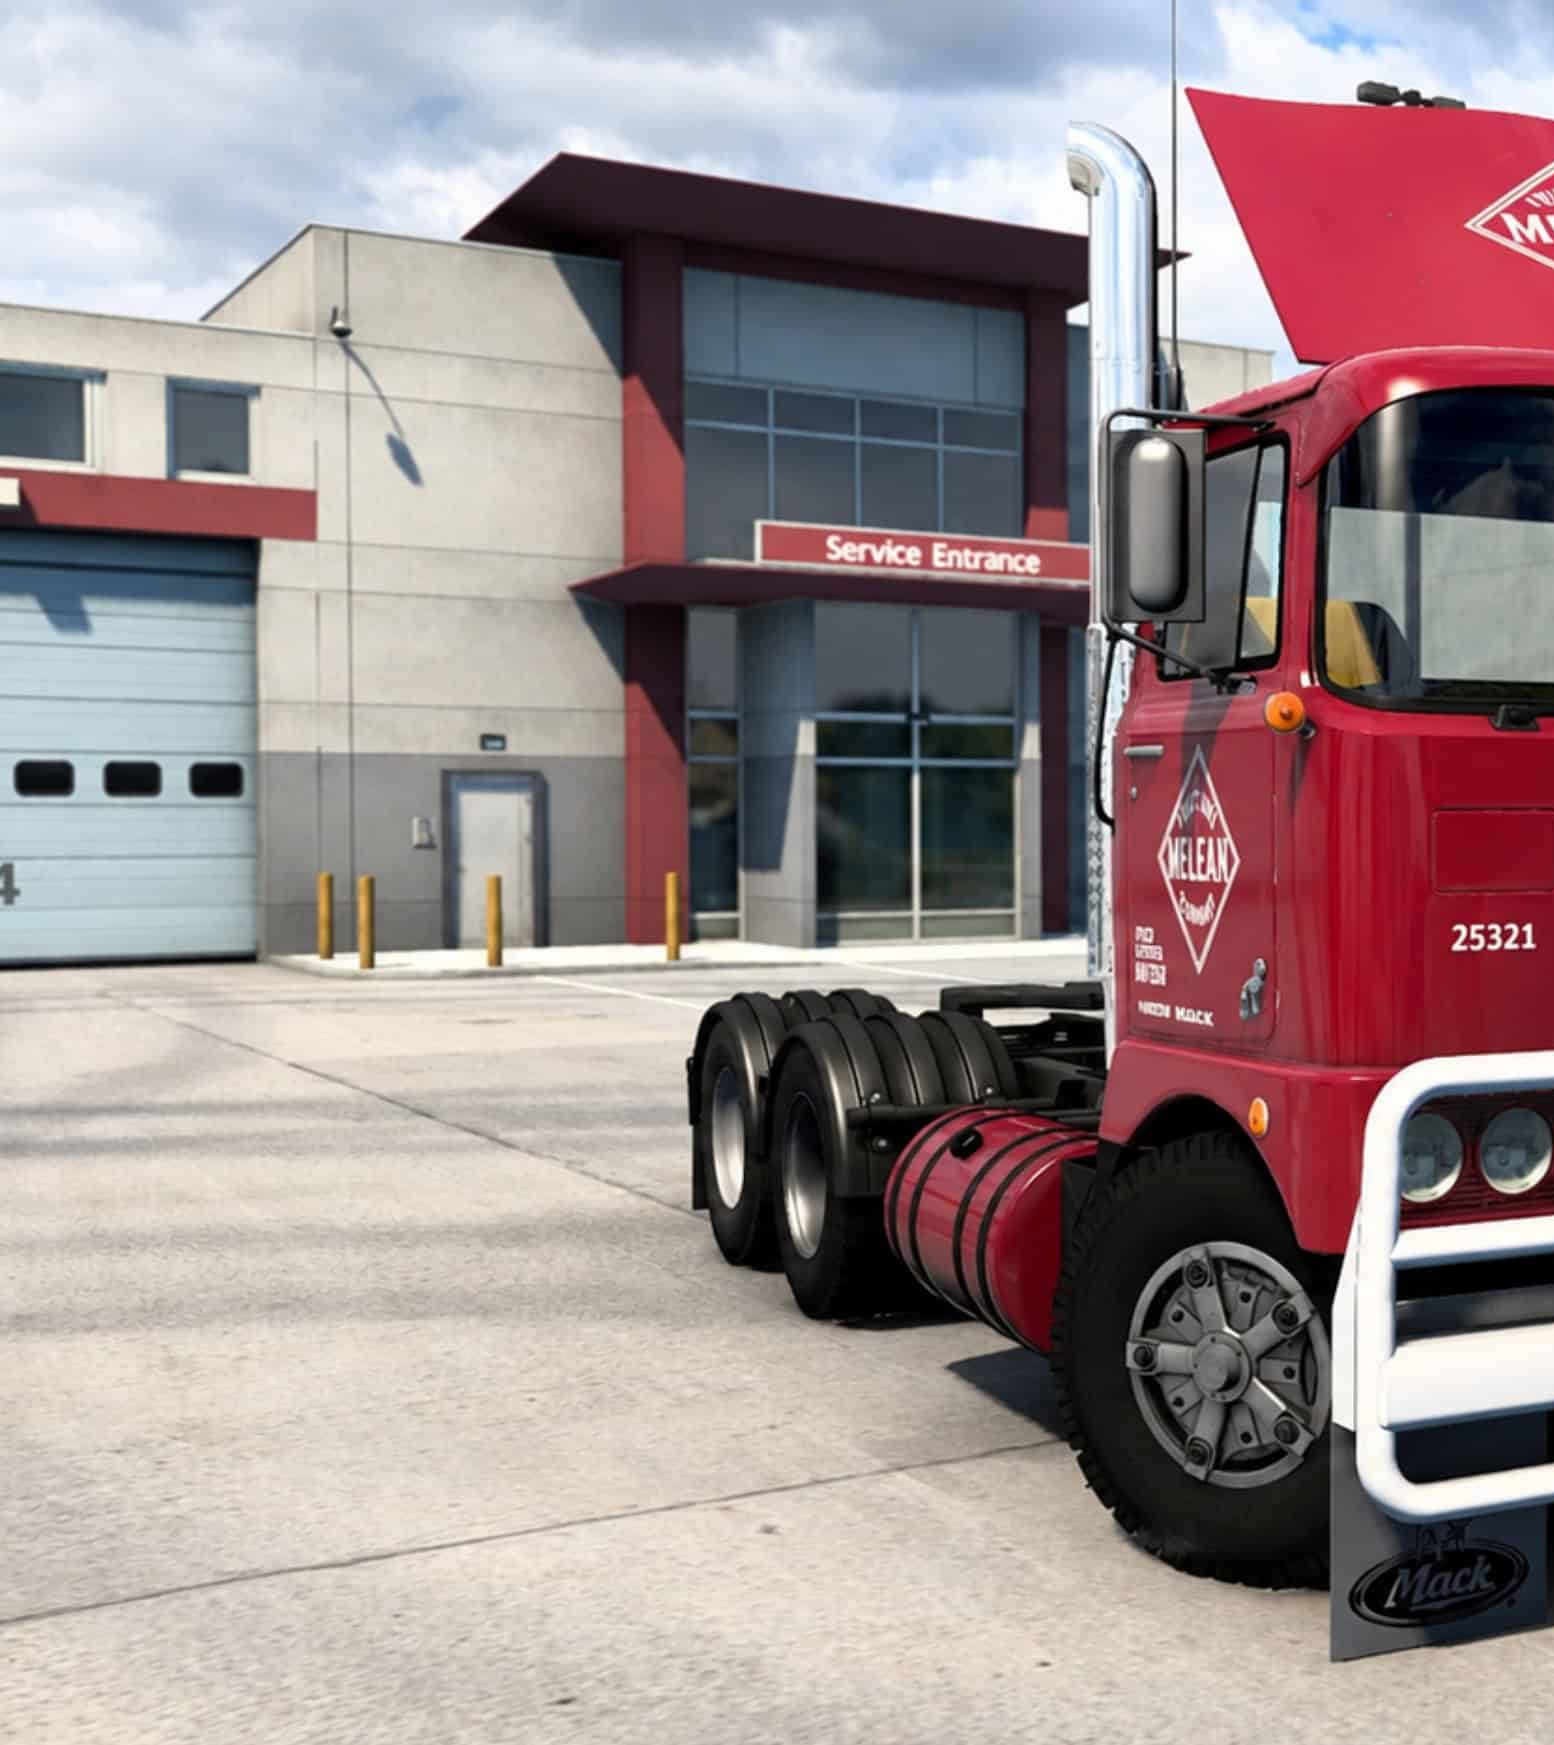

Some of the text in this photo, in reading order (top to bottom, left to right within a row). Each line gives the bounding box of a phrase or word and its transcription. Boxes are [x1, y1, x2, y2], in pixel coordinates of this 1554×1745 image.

[825, 535, 1042, 574] Service Entrance
[1451, 922, 1538, 953] 25321
[1384, 1554, 1497, 1611] Mack
